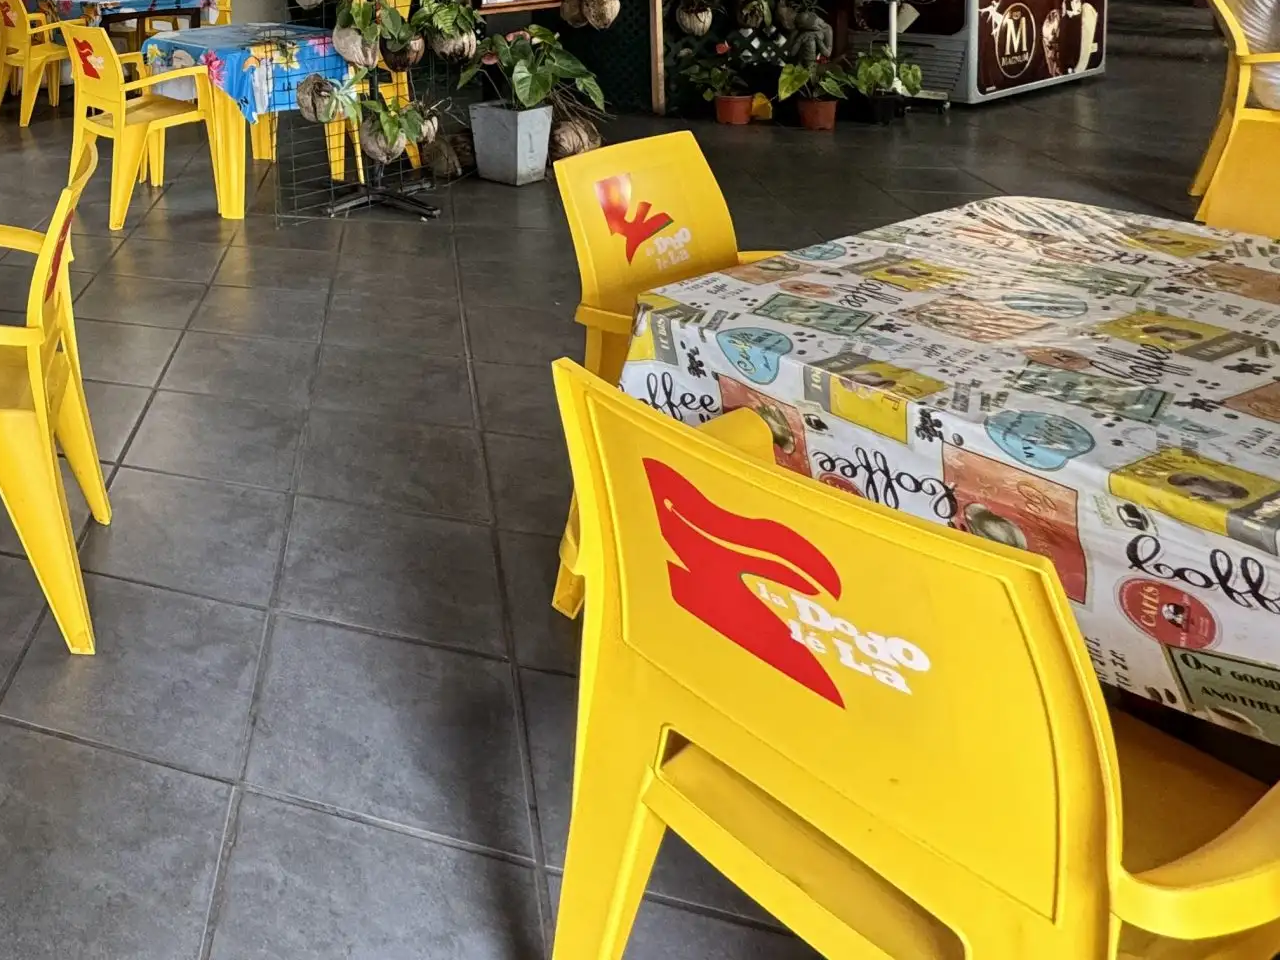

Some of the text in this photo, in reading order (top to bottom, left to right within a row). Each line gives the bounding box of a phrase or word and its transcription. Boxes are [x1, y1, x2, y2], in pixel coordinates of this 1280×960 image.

[1005, 17, 1027, 56] M
[756, 581, 789, 609] la
[832, 637, 914, 696] La
